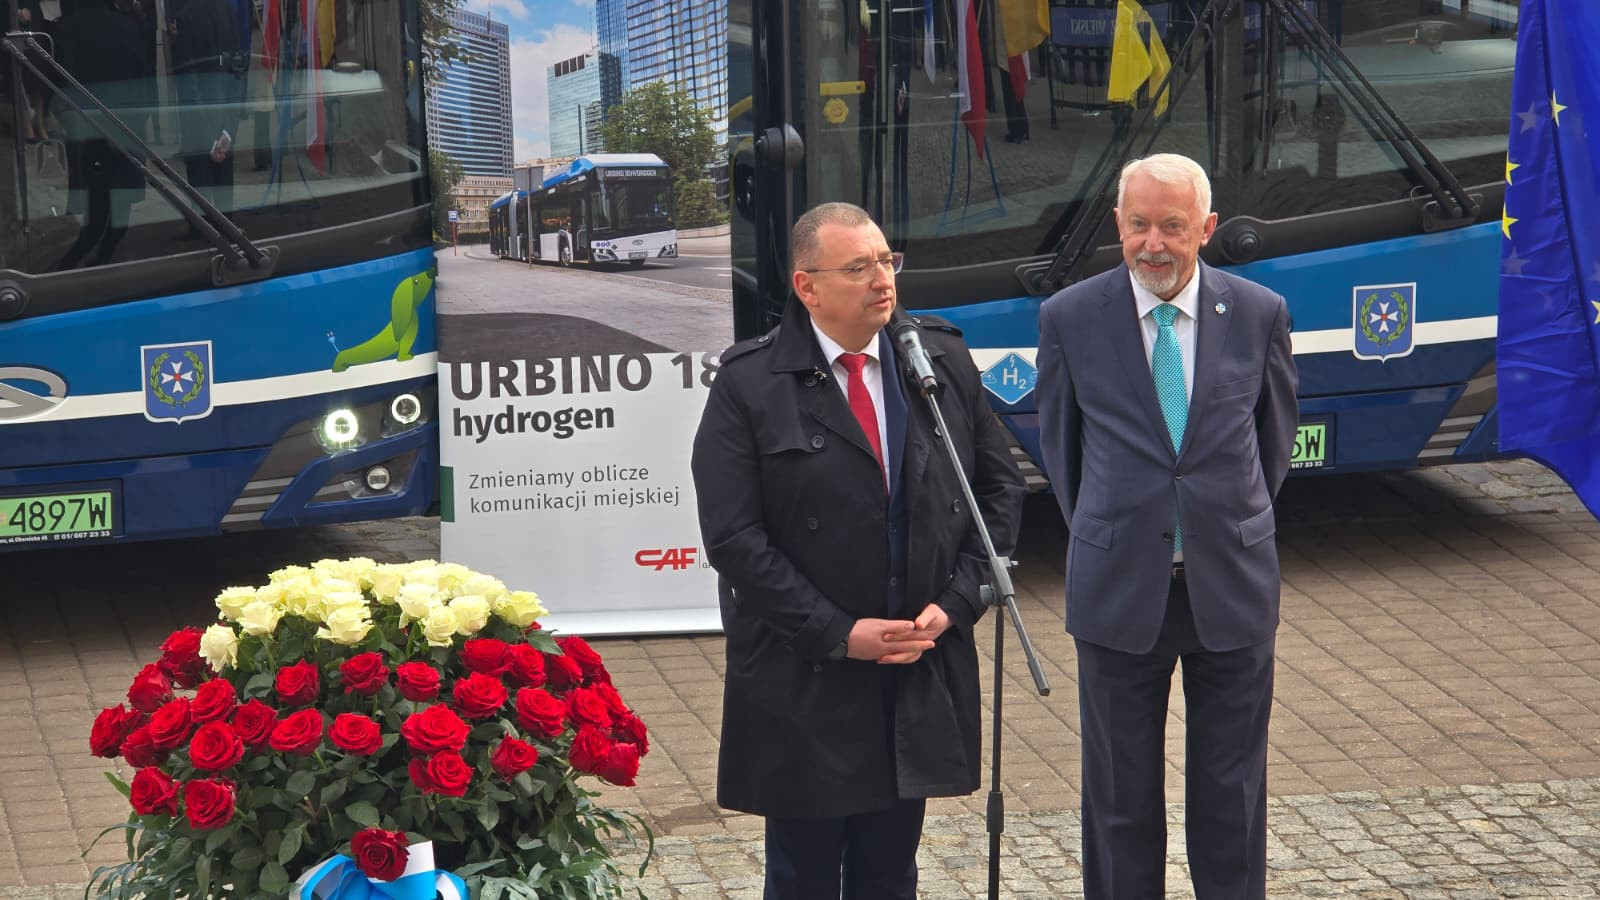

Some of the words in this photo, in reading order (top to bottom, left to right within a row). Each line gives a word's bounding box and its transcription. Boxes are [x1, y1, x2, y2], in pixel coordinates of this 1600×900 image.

[450, 353, 652, 400] URBINO
[670, 352, 722, 388] 18
[453, 405, 615, 443] hydrogen
[469, 469, 575, 490] Zmieniamy
[581, 465, 650, 483] oblicze
[9, 496, 107, 532] 4897W
[470, 491, 587, 513] komunikacji
[594, 486, 680, 509] miejskiej
[635, 547, 697, 571] CAF
